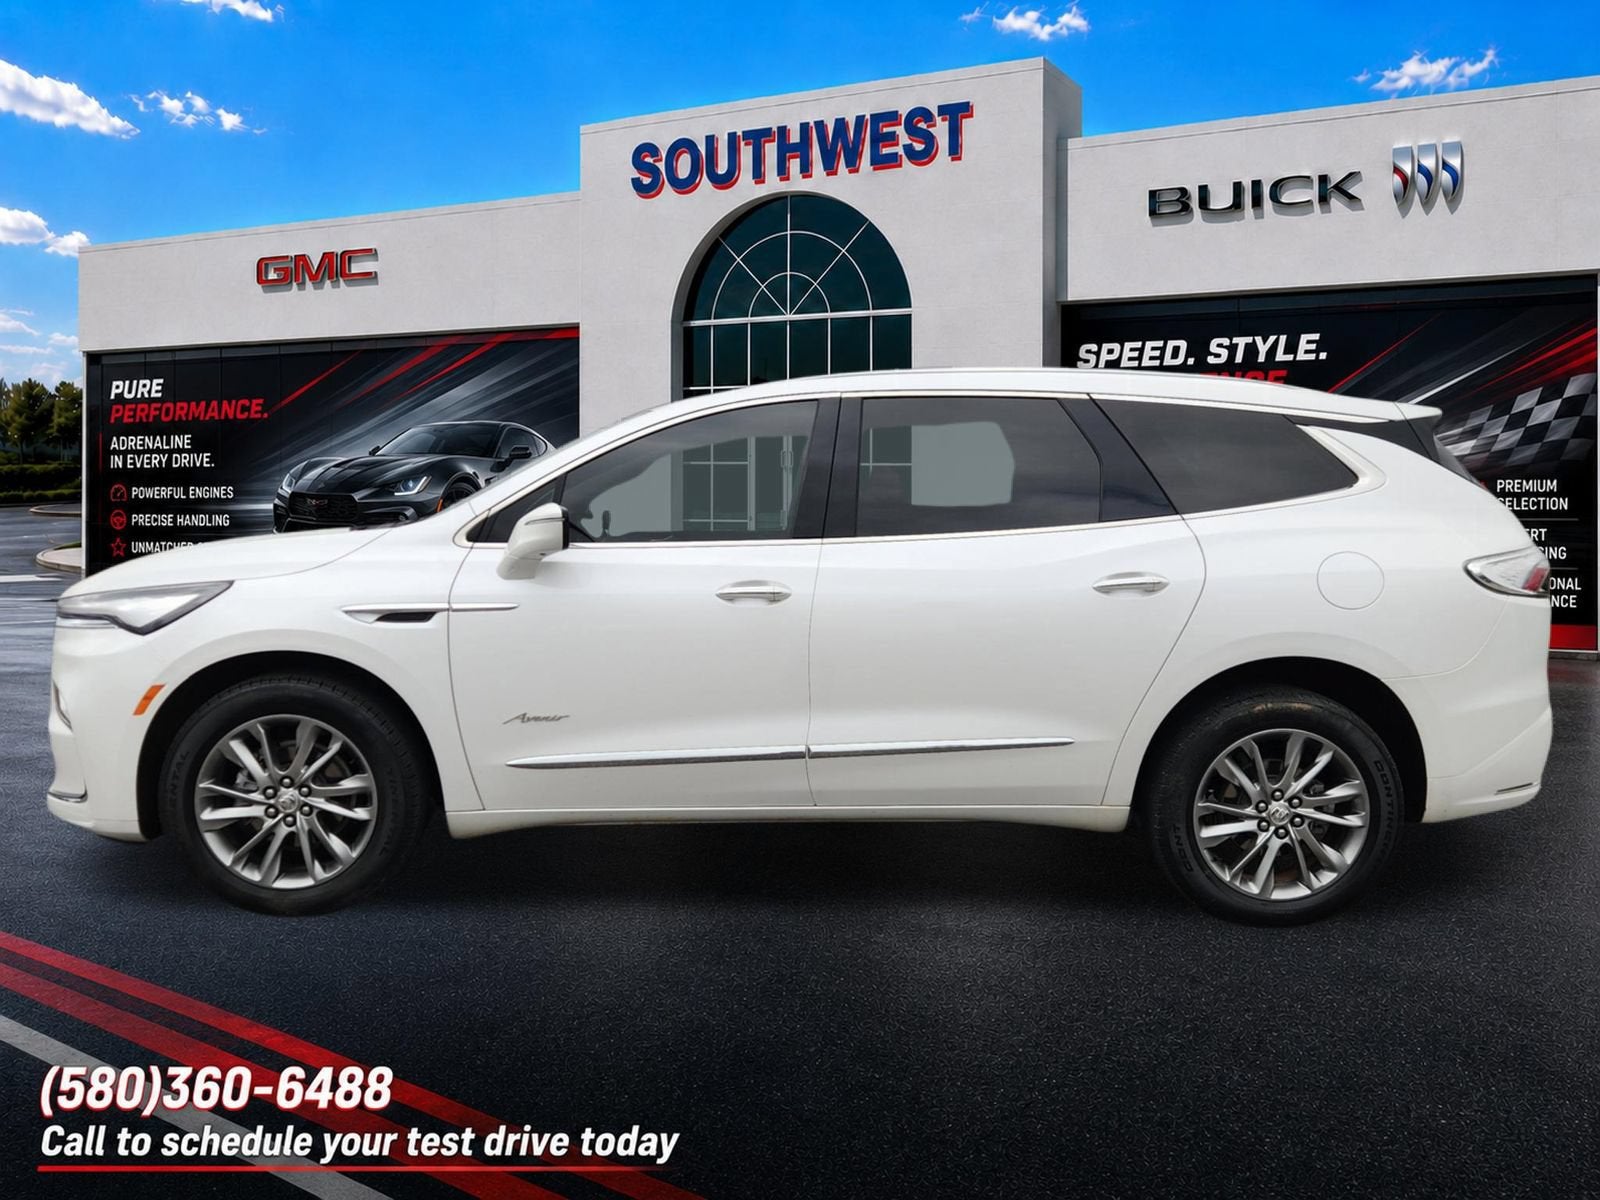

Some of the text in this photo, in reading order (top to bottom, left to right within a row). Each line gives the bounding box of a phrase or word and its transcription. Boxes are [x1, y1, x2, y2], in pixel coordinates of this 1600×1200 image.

[630, 100, 974, 199] SOUTHWEST
[1149, 170, 1363, 218] BUICK
[256, 247, 378, 288] GMC
[1076, 333, 1327, 369] SPEED. STYLE.
[110, 378, 164, 400] PURE
[110, 399, 268, 424] PERFORMANCE.
[110, 434, 192, 450] ADRENALINE
[110, 452, 215, 468] IN EVERY DRIVE.
[131, 486, 234, 499] POWERFUL ENGINES
[1496, 479, 1558, 493] PREMIUM
[1497, 497, 1568, 510] ELECTION
[131, 514, 230, 526] PRECISE HANDLING
